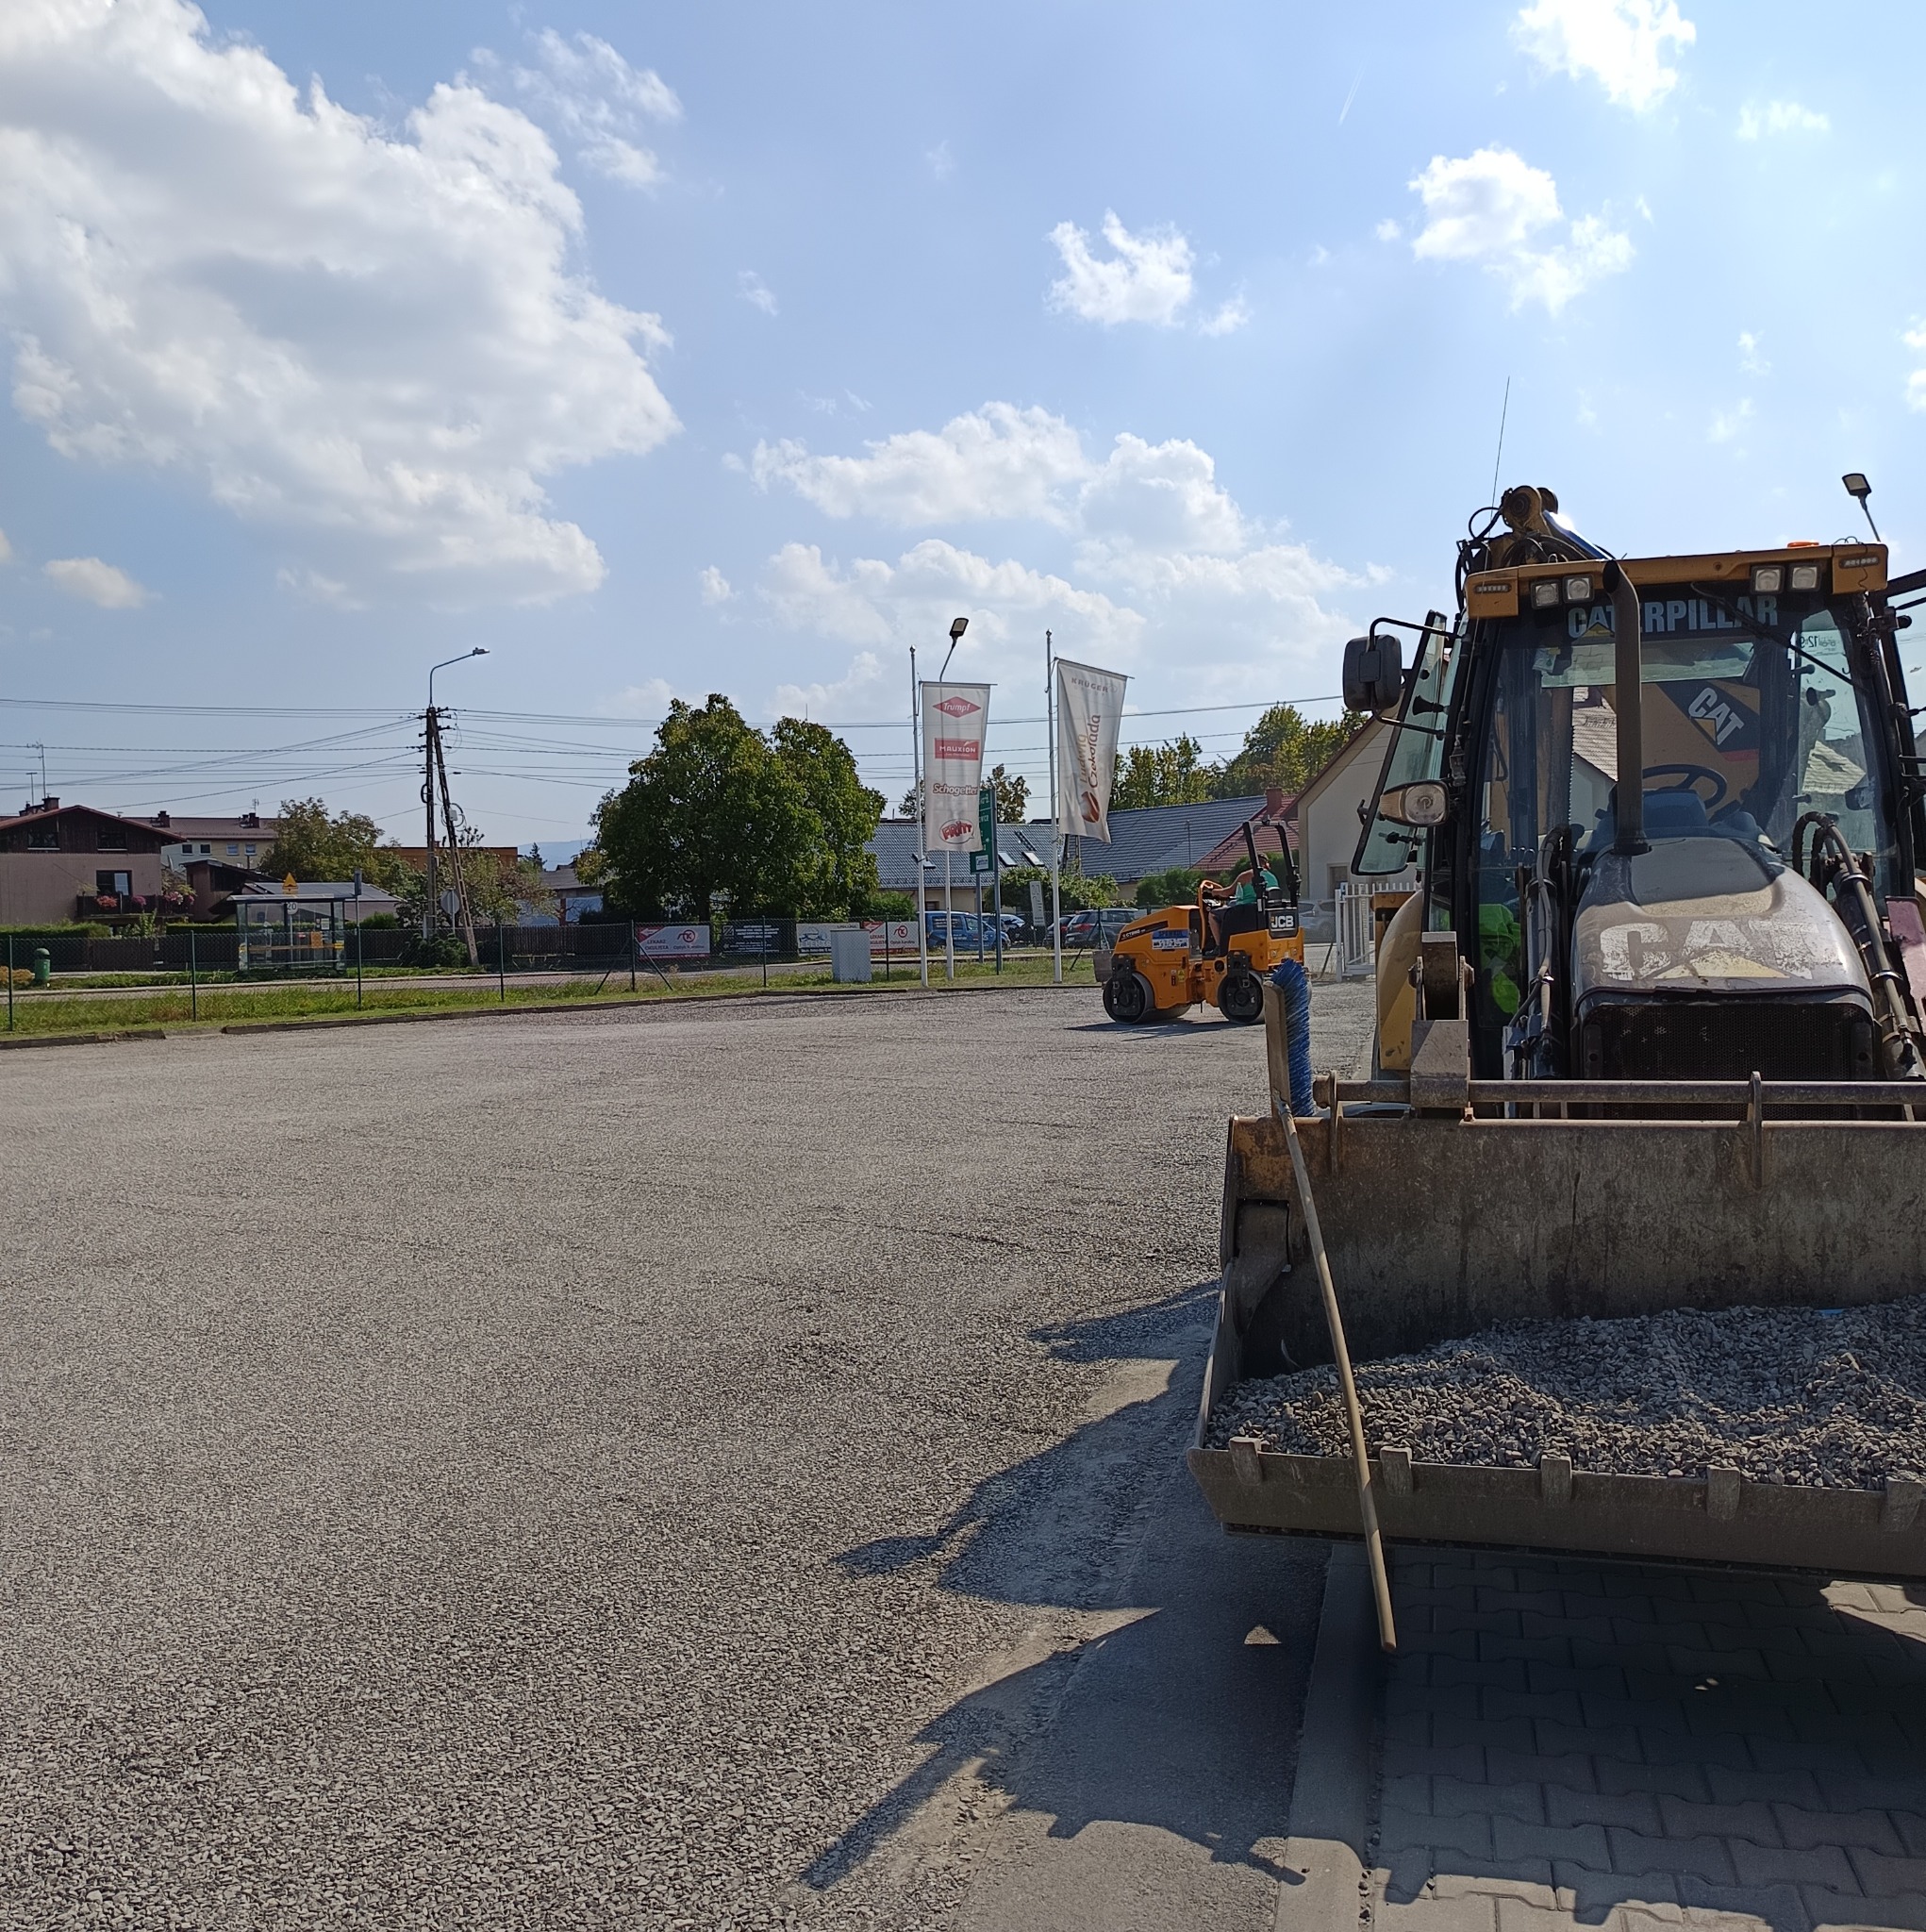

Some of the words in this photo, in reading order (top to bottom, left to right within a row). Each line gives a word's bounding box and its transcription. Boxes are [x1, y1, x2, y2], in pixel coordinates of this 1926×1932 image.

[1568, 595, 1779, 639] CATRPILLAR
[1071, 677, 1108, 692] KRÜGER
[943, 702, 971, 713] Trumpf
[1688, 687, 1745, 746] CAT
[1077, 734, 1088, 784] Ludwig
[287, 902, 297, 910] 20
[1270, 915, 1294, 928] JCB
[1600, 920, 1819, 981] CAT
